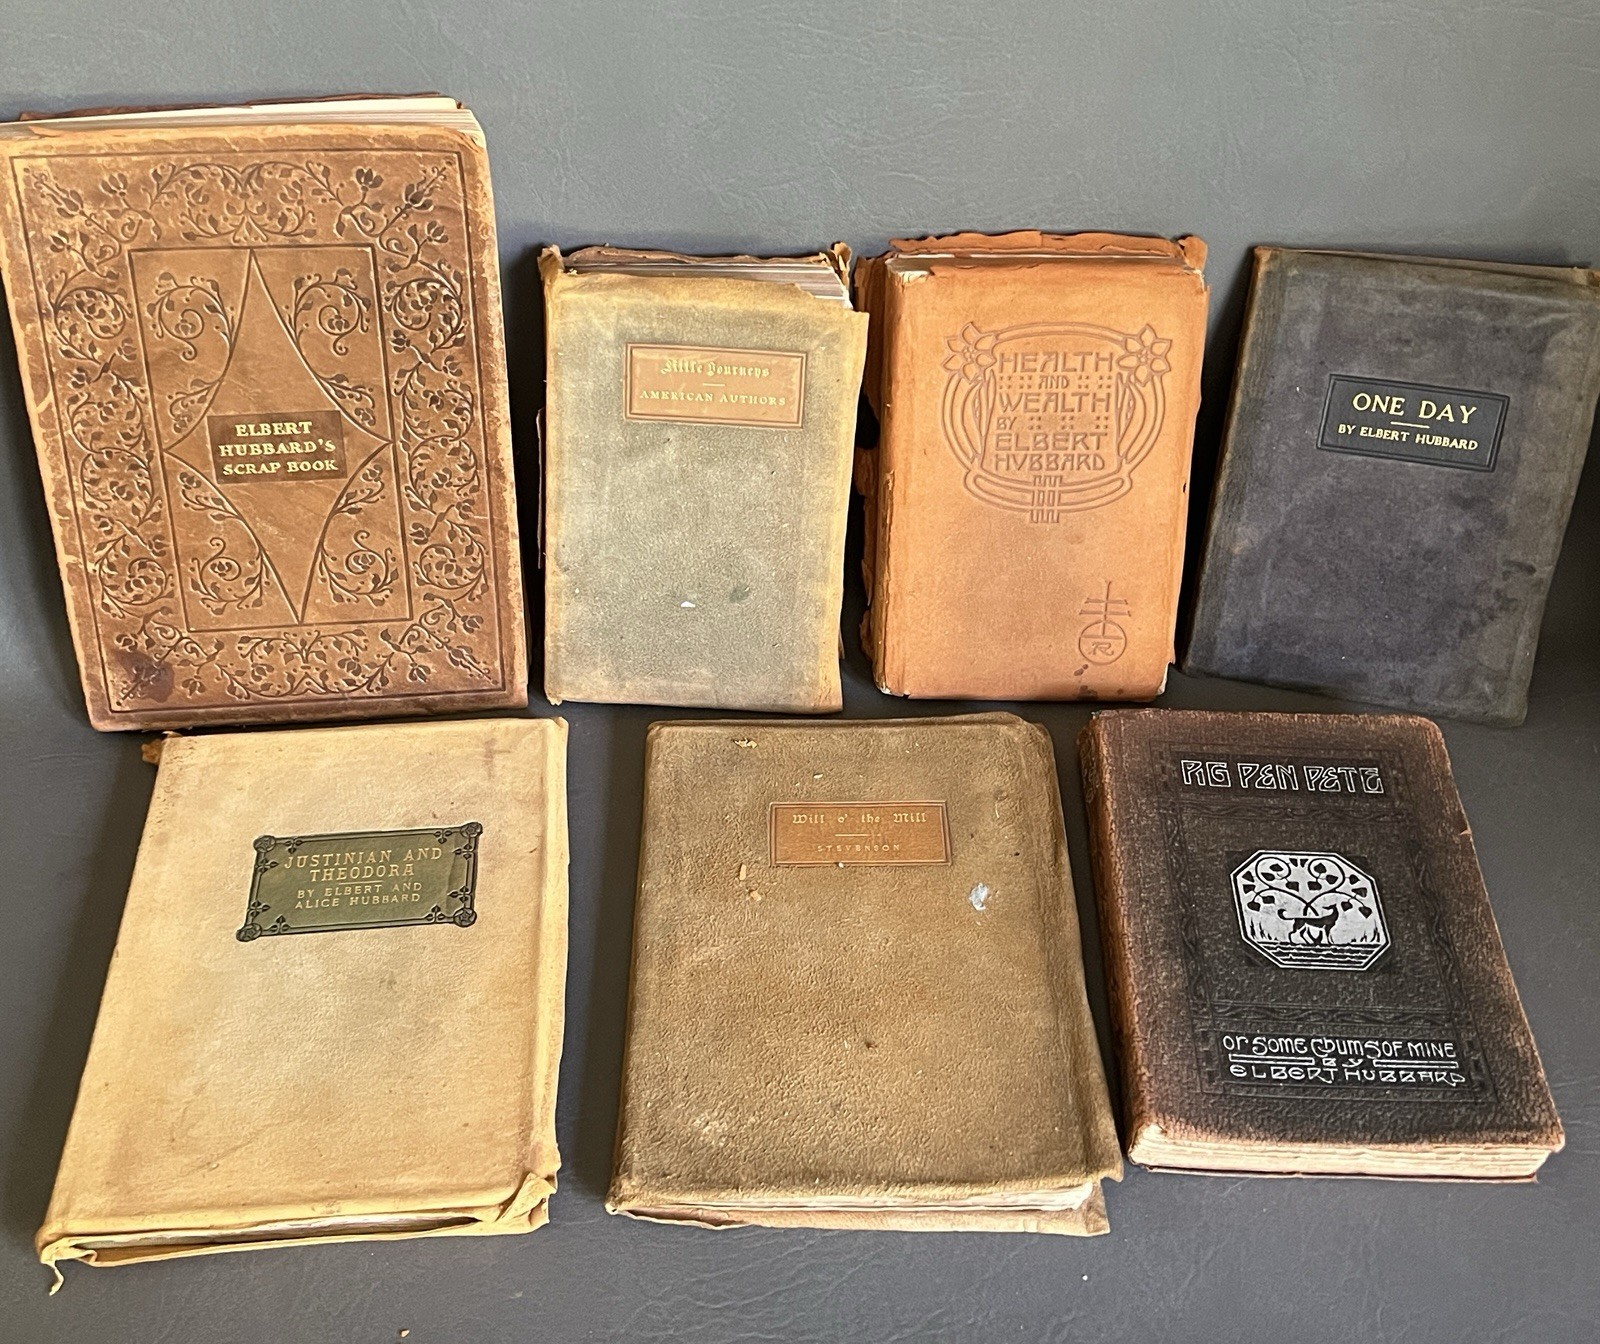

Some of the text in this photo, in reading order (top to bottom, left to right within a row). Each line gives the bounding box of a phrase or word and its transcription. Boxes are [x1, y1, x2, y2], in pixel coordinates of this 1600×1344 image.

[999, 352, 1114, 373] HEALTH
[1038, 375, 1069, 389] AND
[640, 390, 786, 406] AMERICAN AUTHORS
[1000, 392, 1111, 412] WEALTH
[1352, 392, 1477, 424] ONE DAY
[235, 421, 312, 437] ELBERT
[996, 416, 1017, 430] BY
[995, 432, 1108, 451] ELBERT
[1338, 424, 1478, 450] BY ELBERT HUBBARD
[222, 459, 338, 475] SCRAP BOOK
[1237, 763, 1299, 791] PEN
[1303, 766, 1384, 794] PETE
[792, 814, 825, 824] Will
[861, 813, 881, 824] the
[893, 812, 927, 823] Mill
[817, 844, 900, 852] STEVENSON
[284, 847, 442, 868] JUSTINIAN AND
[309, 863, 415, 882] THEODORA
[297, 882, 423, 899] BY ELBERT AND
[295, 893, 421, 909] ALICE HUBBARD
[1407, 1042, 1457, 1058] MINE
[1229, 1064, 1466, 1087] ELBERT HUBBARD
